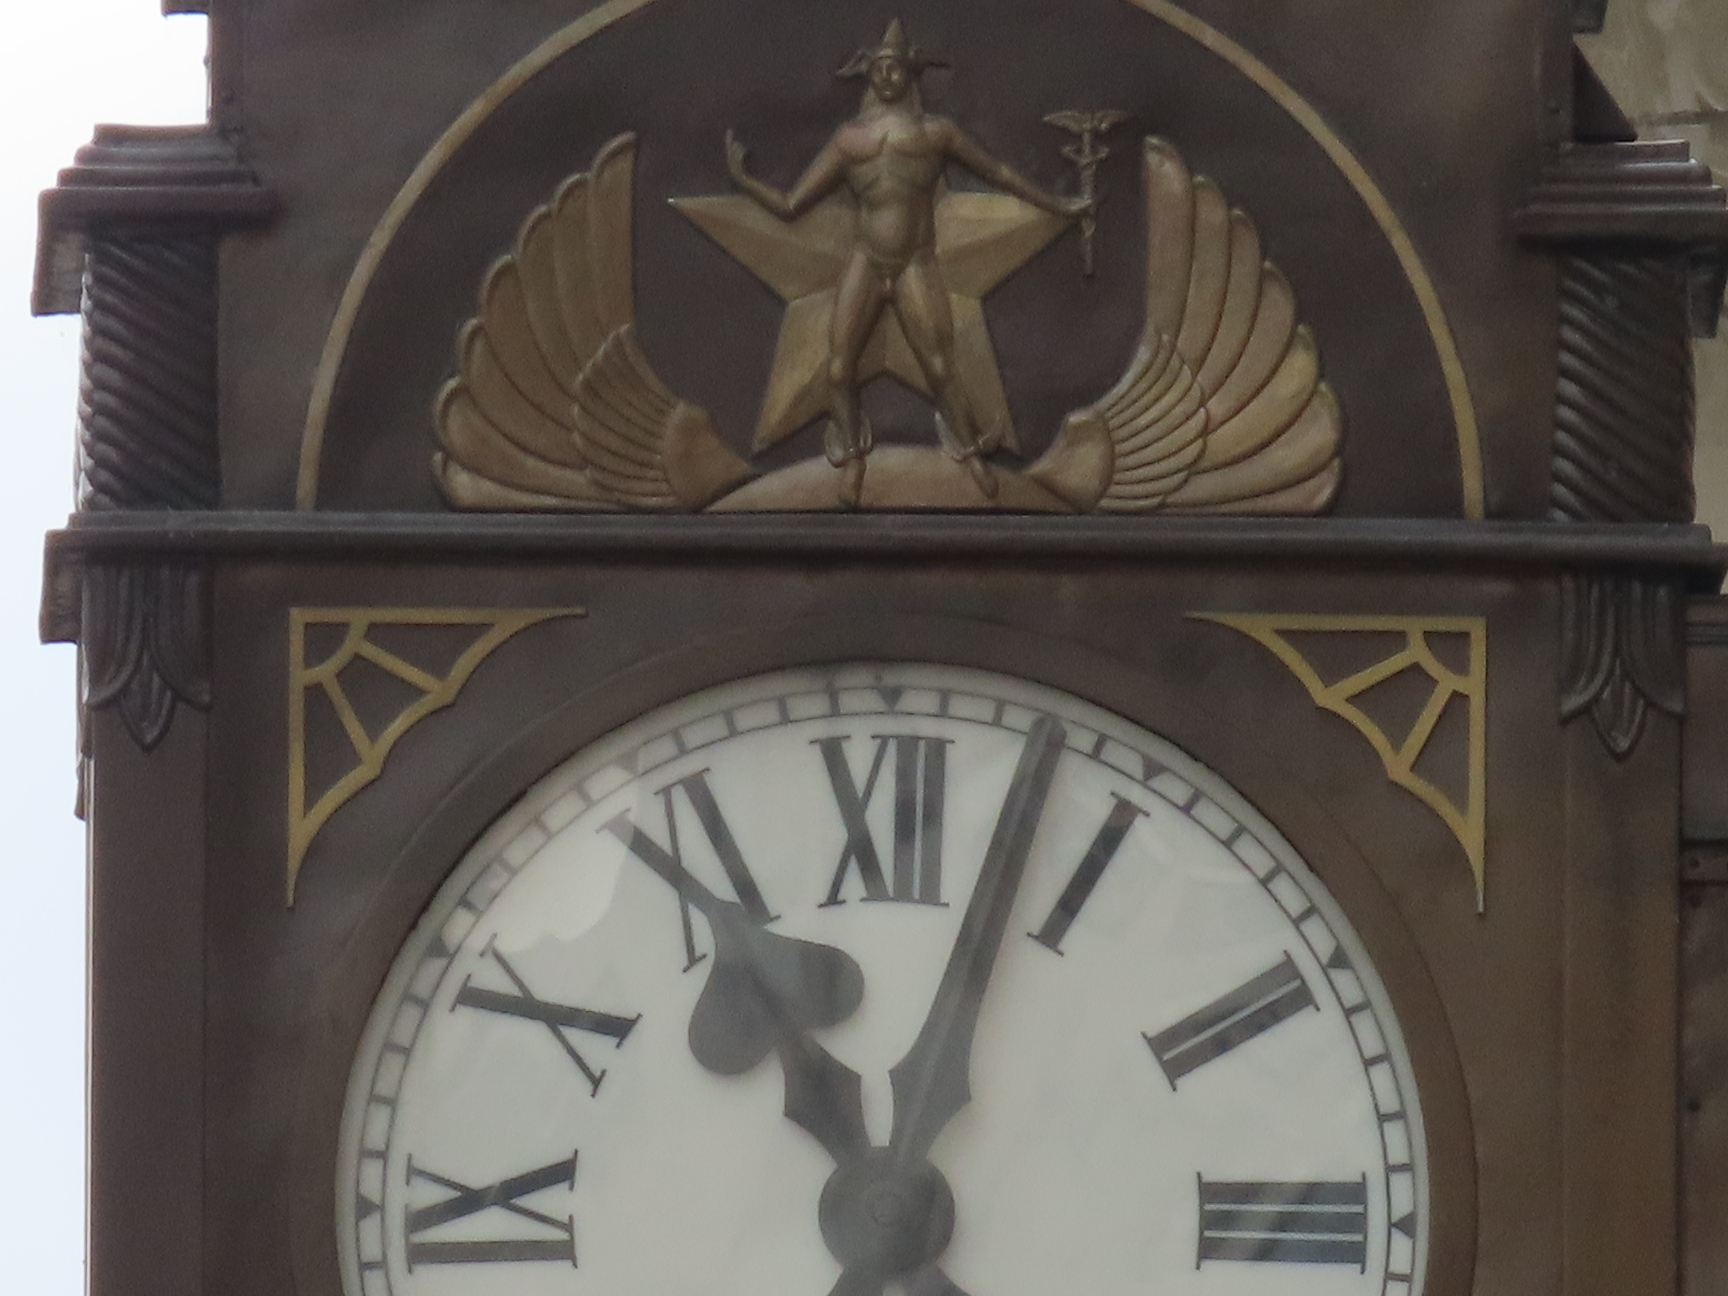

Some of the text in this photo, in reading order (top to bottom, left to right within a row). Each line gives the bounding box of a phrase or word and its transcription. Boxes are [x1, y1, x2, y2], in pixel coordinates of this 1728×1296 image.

[598, 768, 782, 972] XI
[810, 735, 955, 907] XII
[450, 934, 642, 1097] X
[1141, 950, 1320, 1090] II
[405, 1150, 579, 1275] IX
[1196, 1171, 1368, 1275] III
